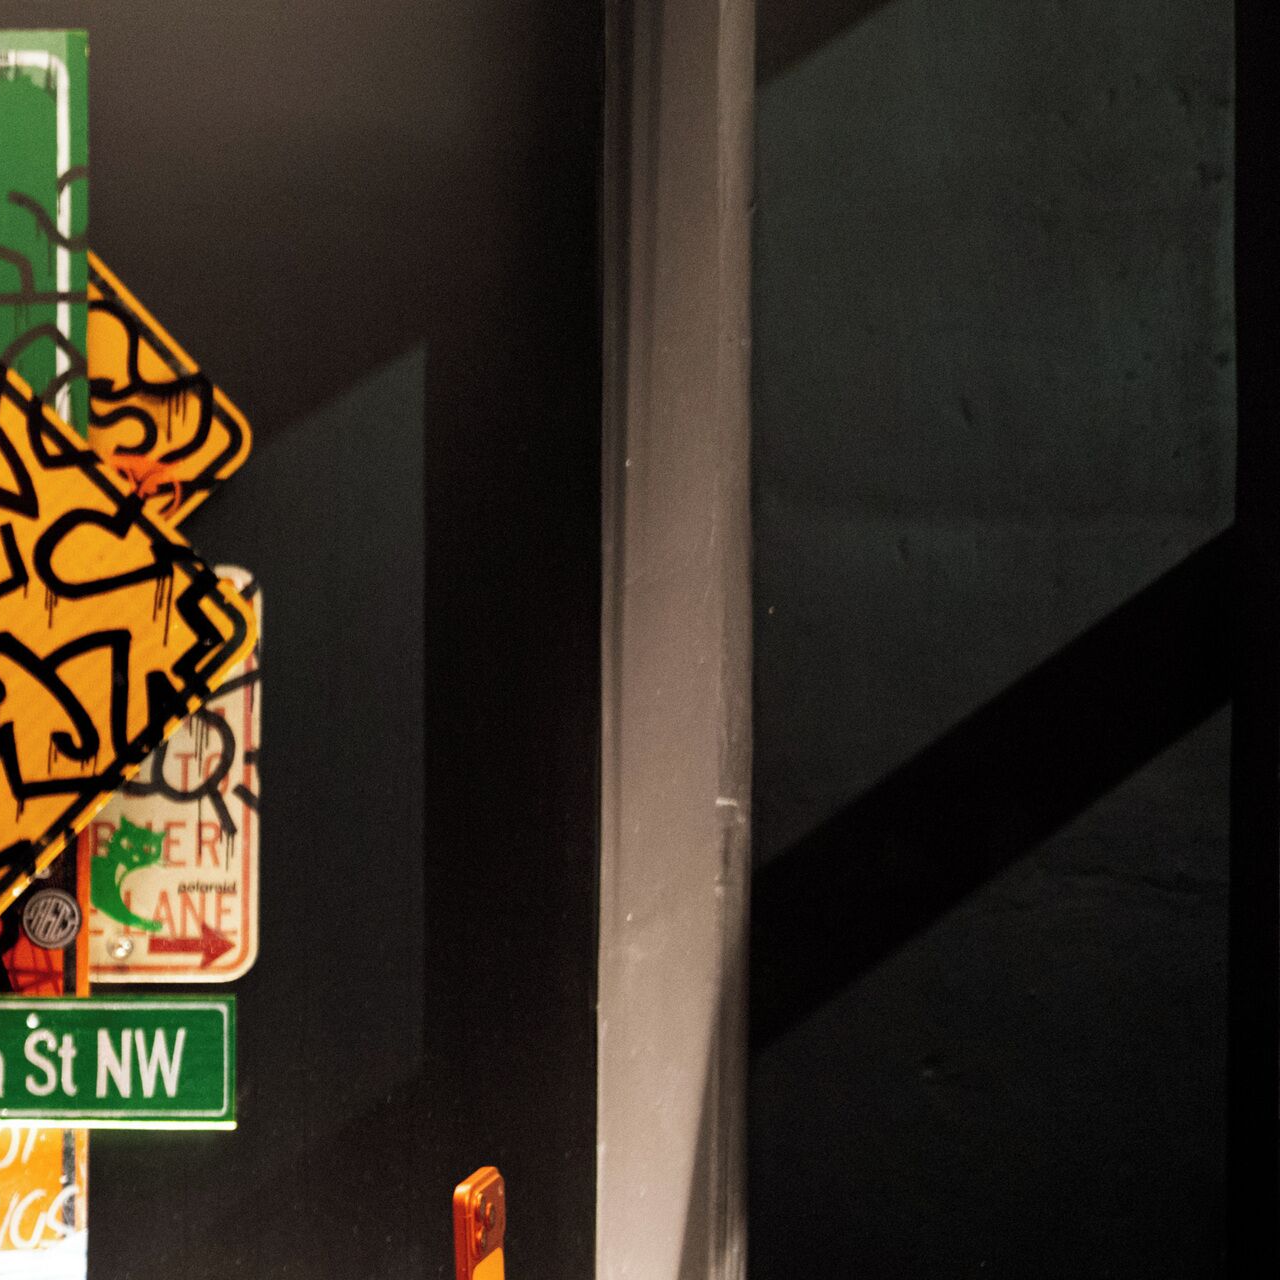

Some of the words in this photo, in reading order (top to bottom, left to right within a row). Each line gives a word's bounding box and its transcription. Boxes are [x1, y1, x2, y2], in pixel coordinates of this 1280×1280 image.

[123, 890, 237, 937] LANE
[23, 1029, 77, 1098] St
[96, 1027, 187, 1099] NW
